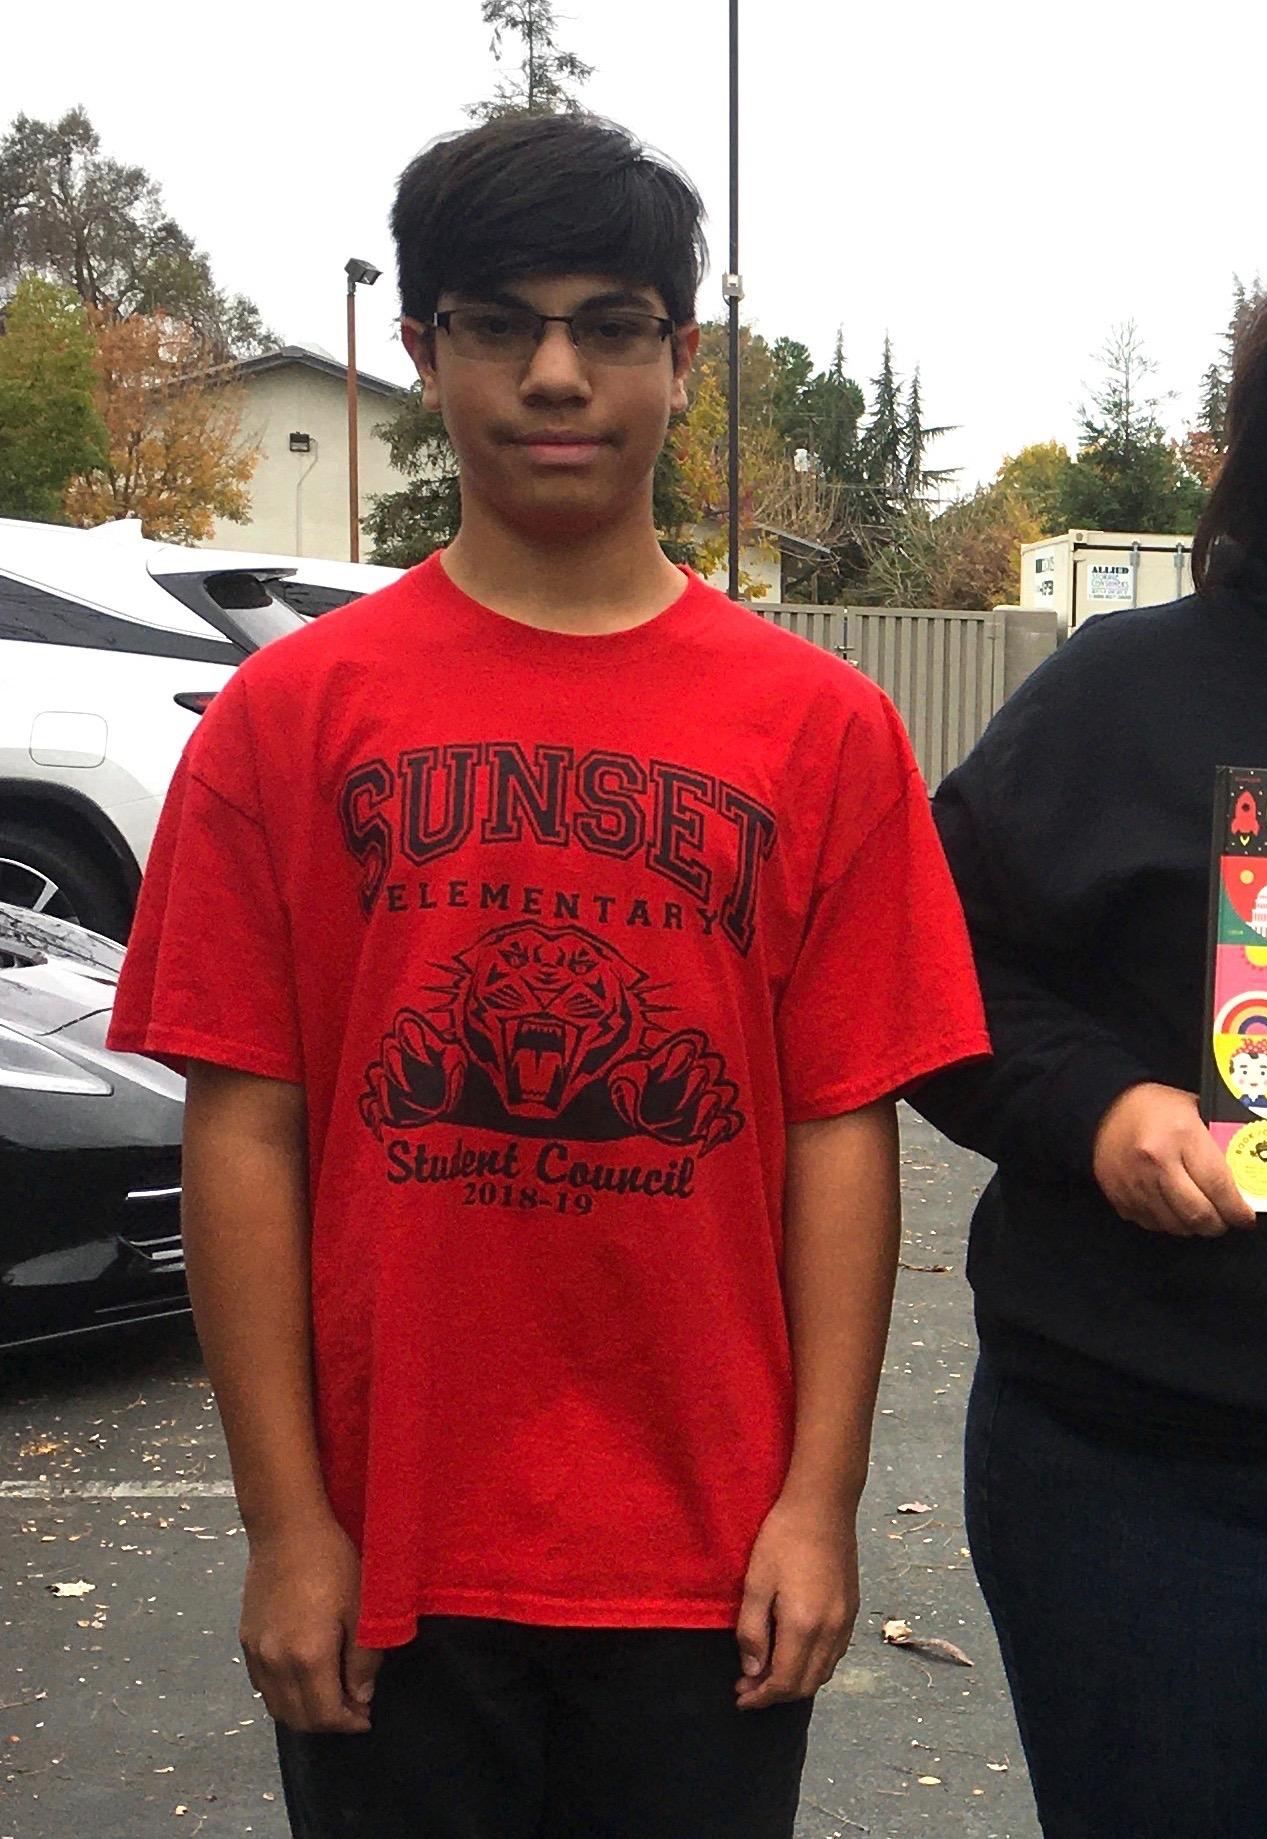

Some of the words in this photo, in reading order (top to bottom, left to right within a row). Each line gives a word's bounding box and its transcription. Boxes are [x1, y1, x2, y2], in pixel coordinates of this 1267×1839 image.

[1092, 566, 1129, 574] ALLIED
[339, 742, 778, 957] SUNSET
[388, 879, 724, 936] ELEMENTARY
[1235, 1133, 1254, 1154] BOOK
[387, 1139, 520, 1184] Student
[535, 1142, 695, 1199] Council
[463, 1182, 594, 1216] 2018-19
